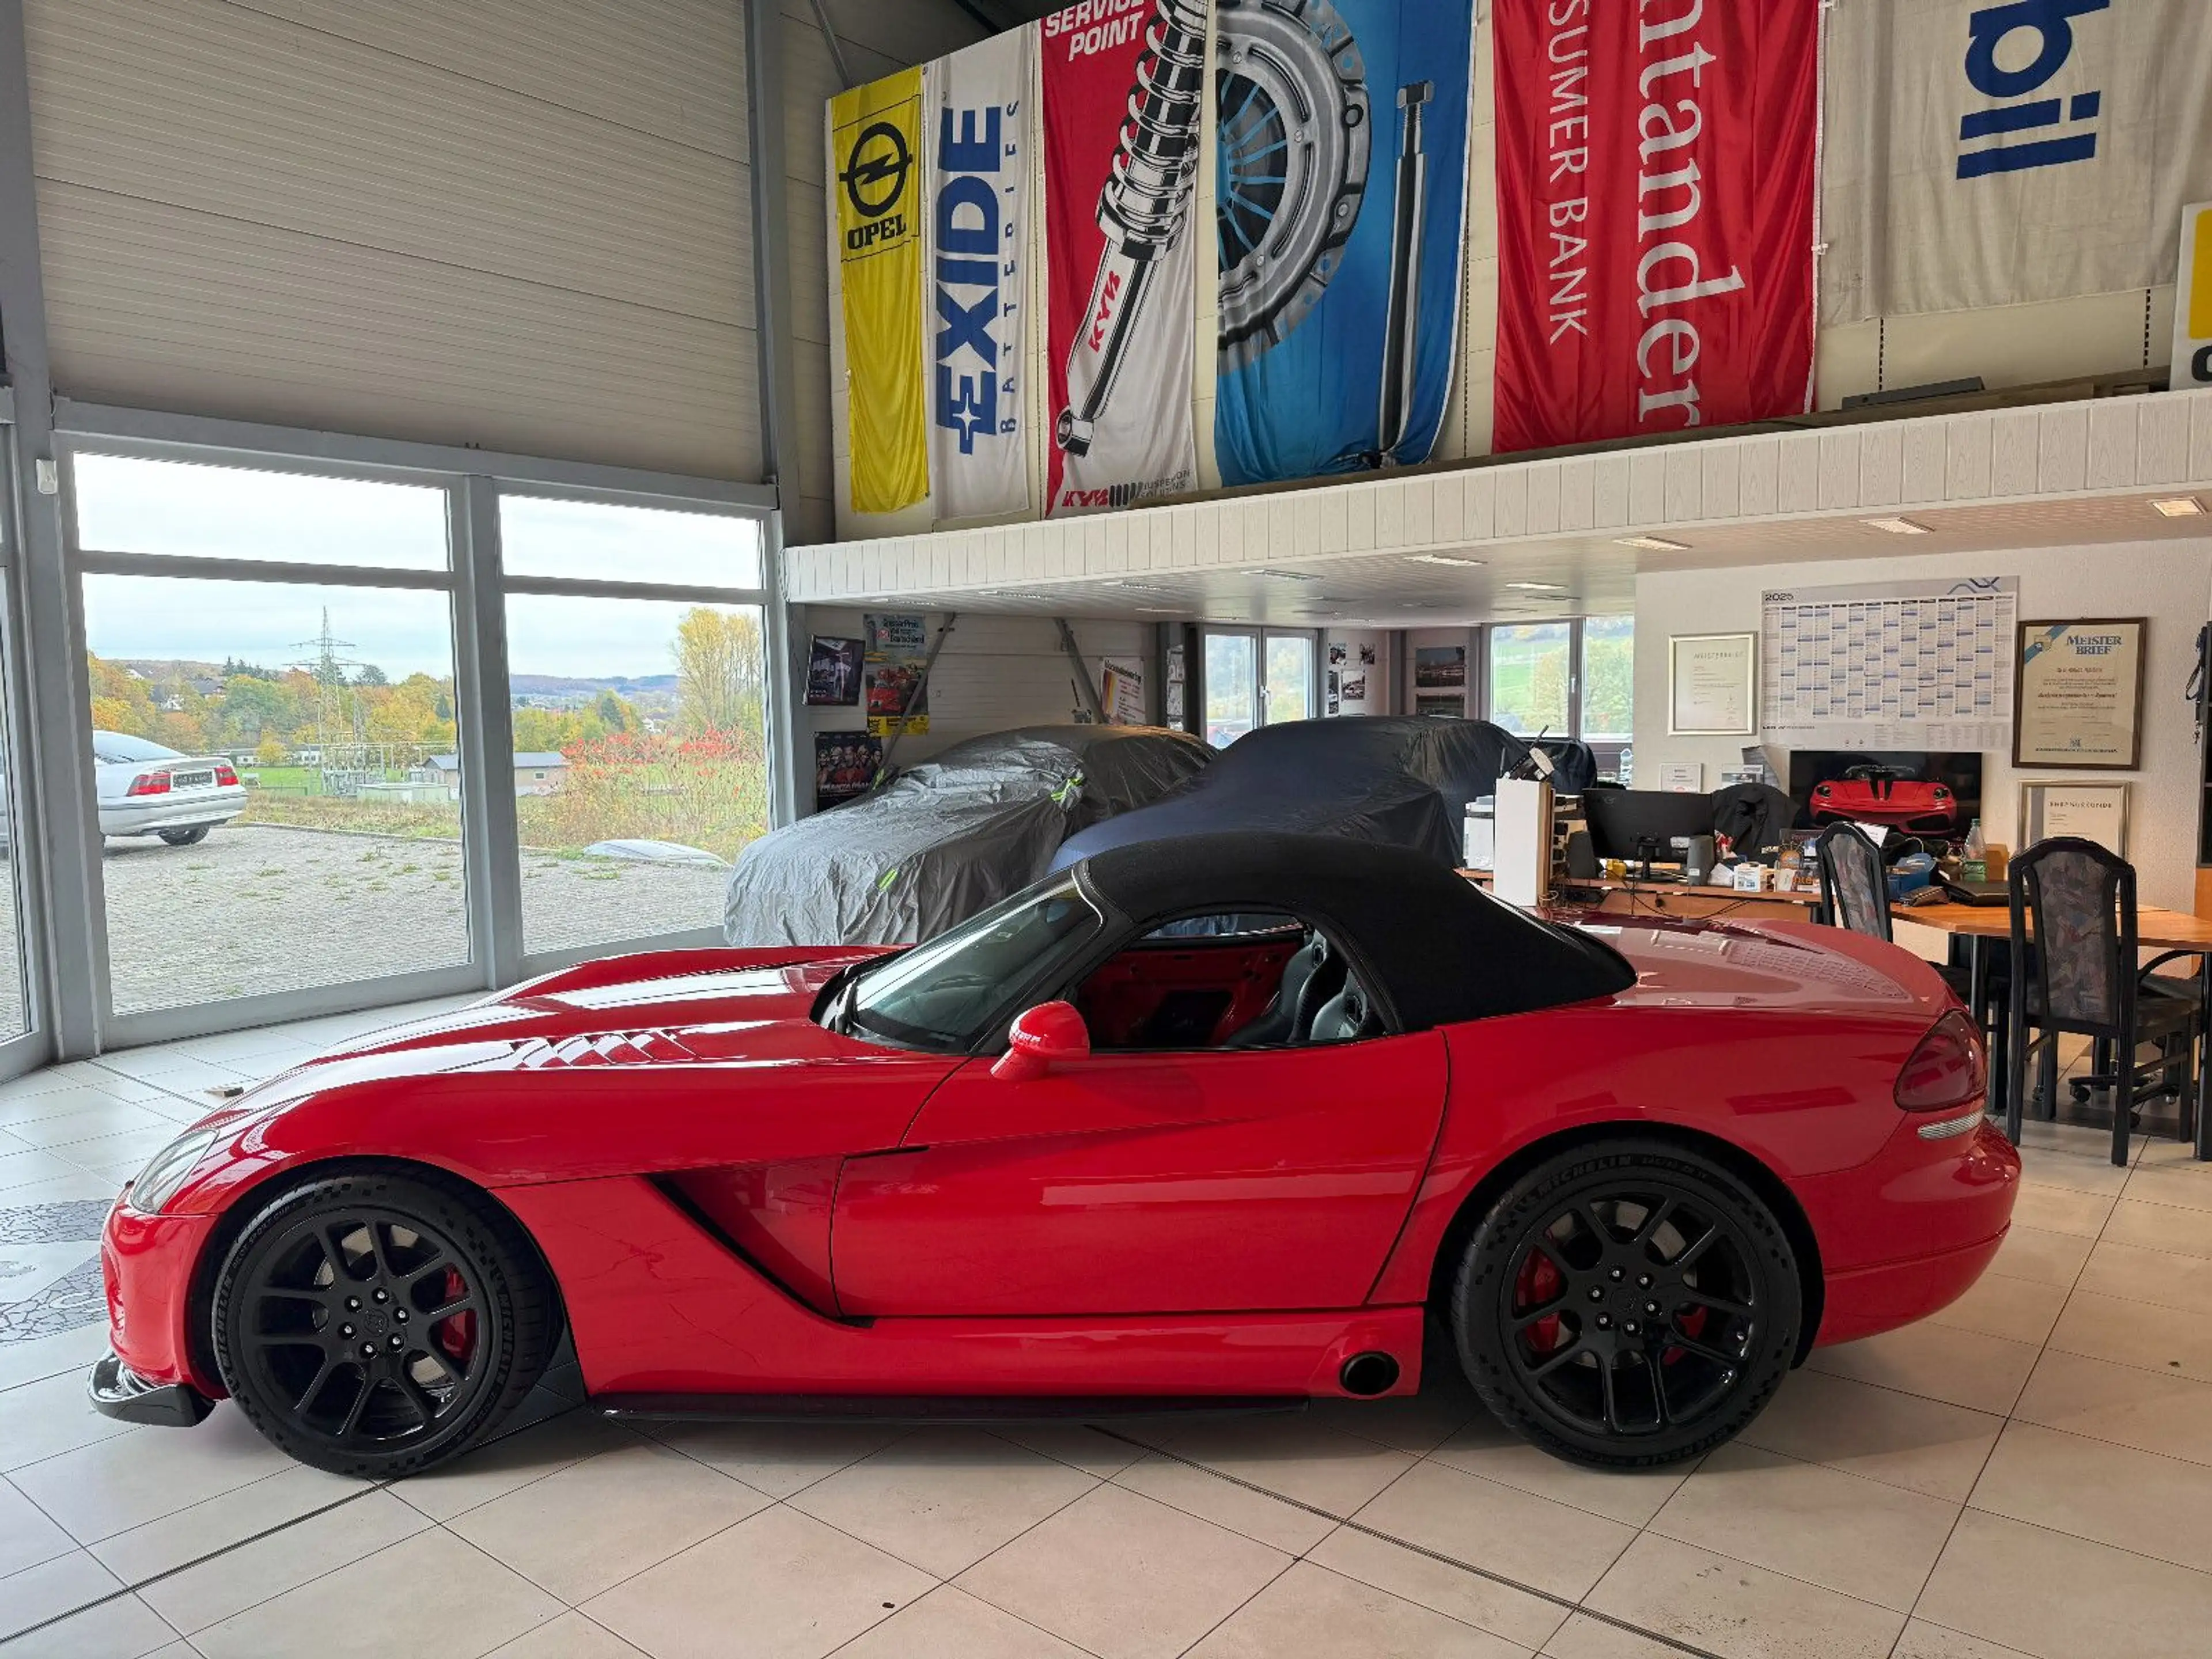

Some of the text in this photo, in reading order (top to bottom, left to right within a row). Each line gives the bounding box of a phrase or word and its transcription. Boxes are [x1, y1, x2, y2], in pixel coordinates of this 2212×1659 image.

[1069, 10, 1144, 61] POINT
[847, 213, 907, 249] OPEL
[936, 106, 1001, 454] EXIDE
[1550, 197, 1588, 345] BANK
[1088, 271, 1121, 353] KYB
[1062, 488, 1108, 507] KYB
[1765, 593, 1794, 601] 2025
[2066, 635, 2122, 646] MEISTER
[2075, 645, 2112, 655] BRIEF
